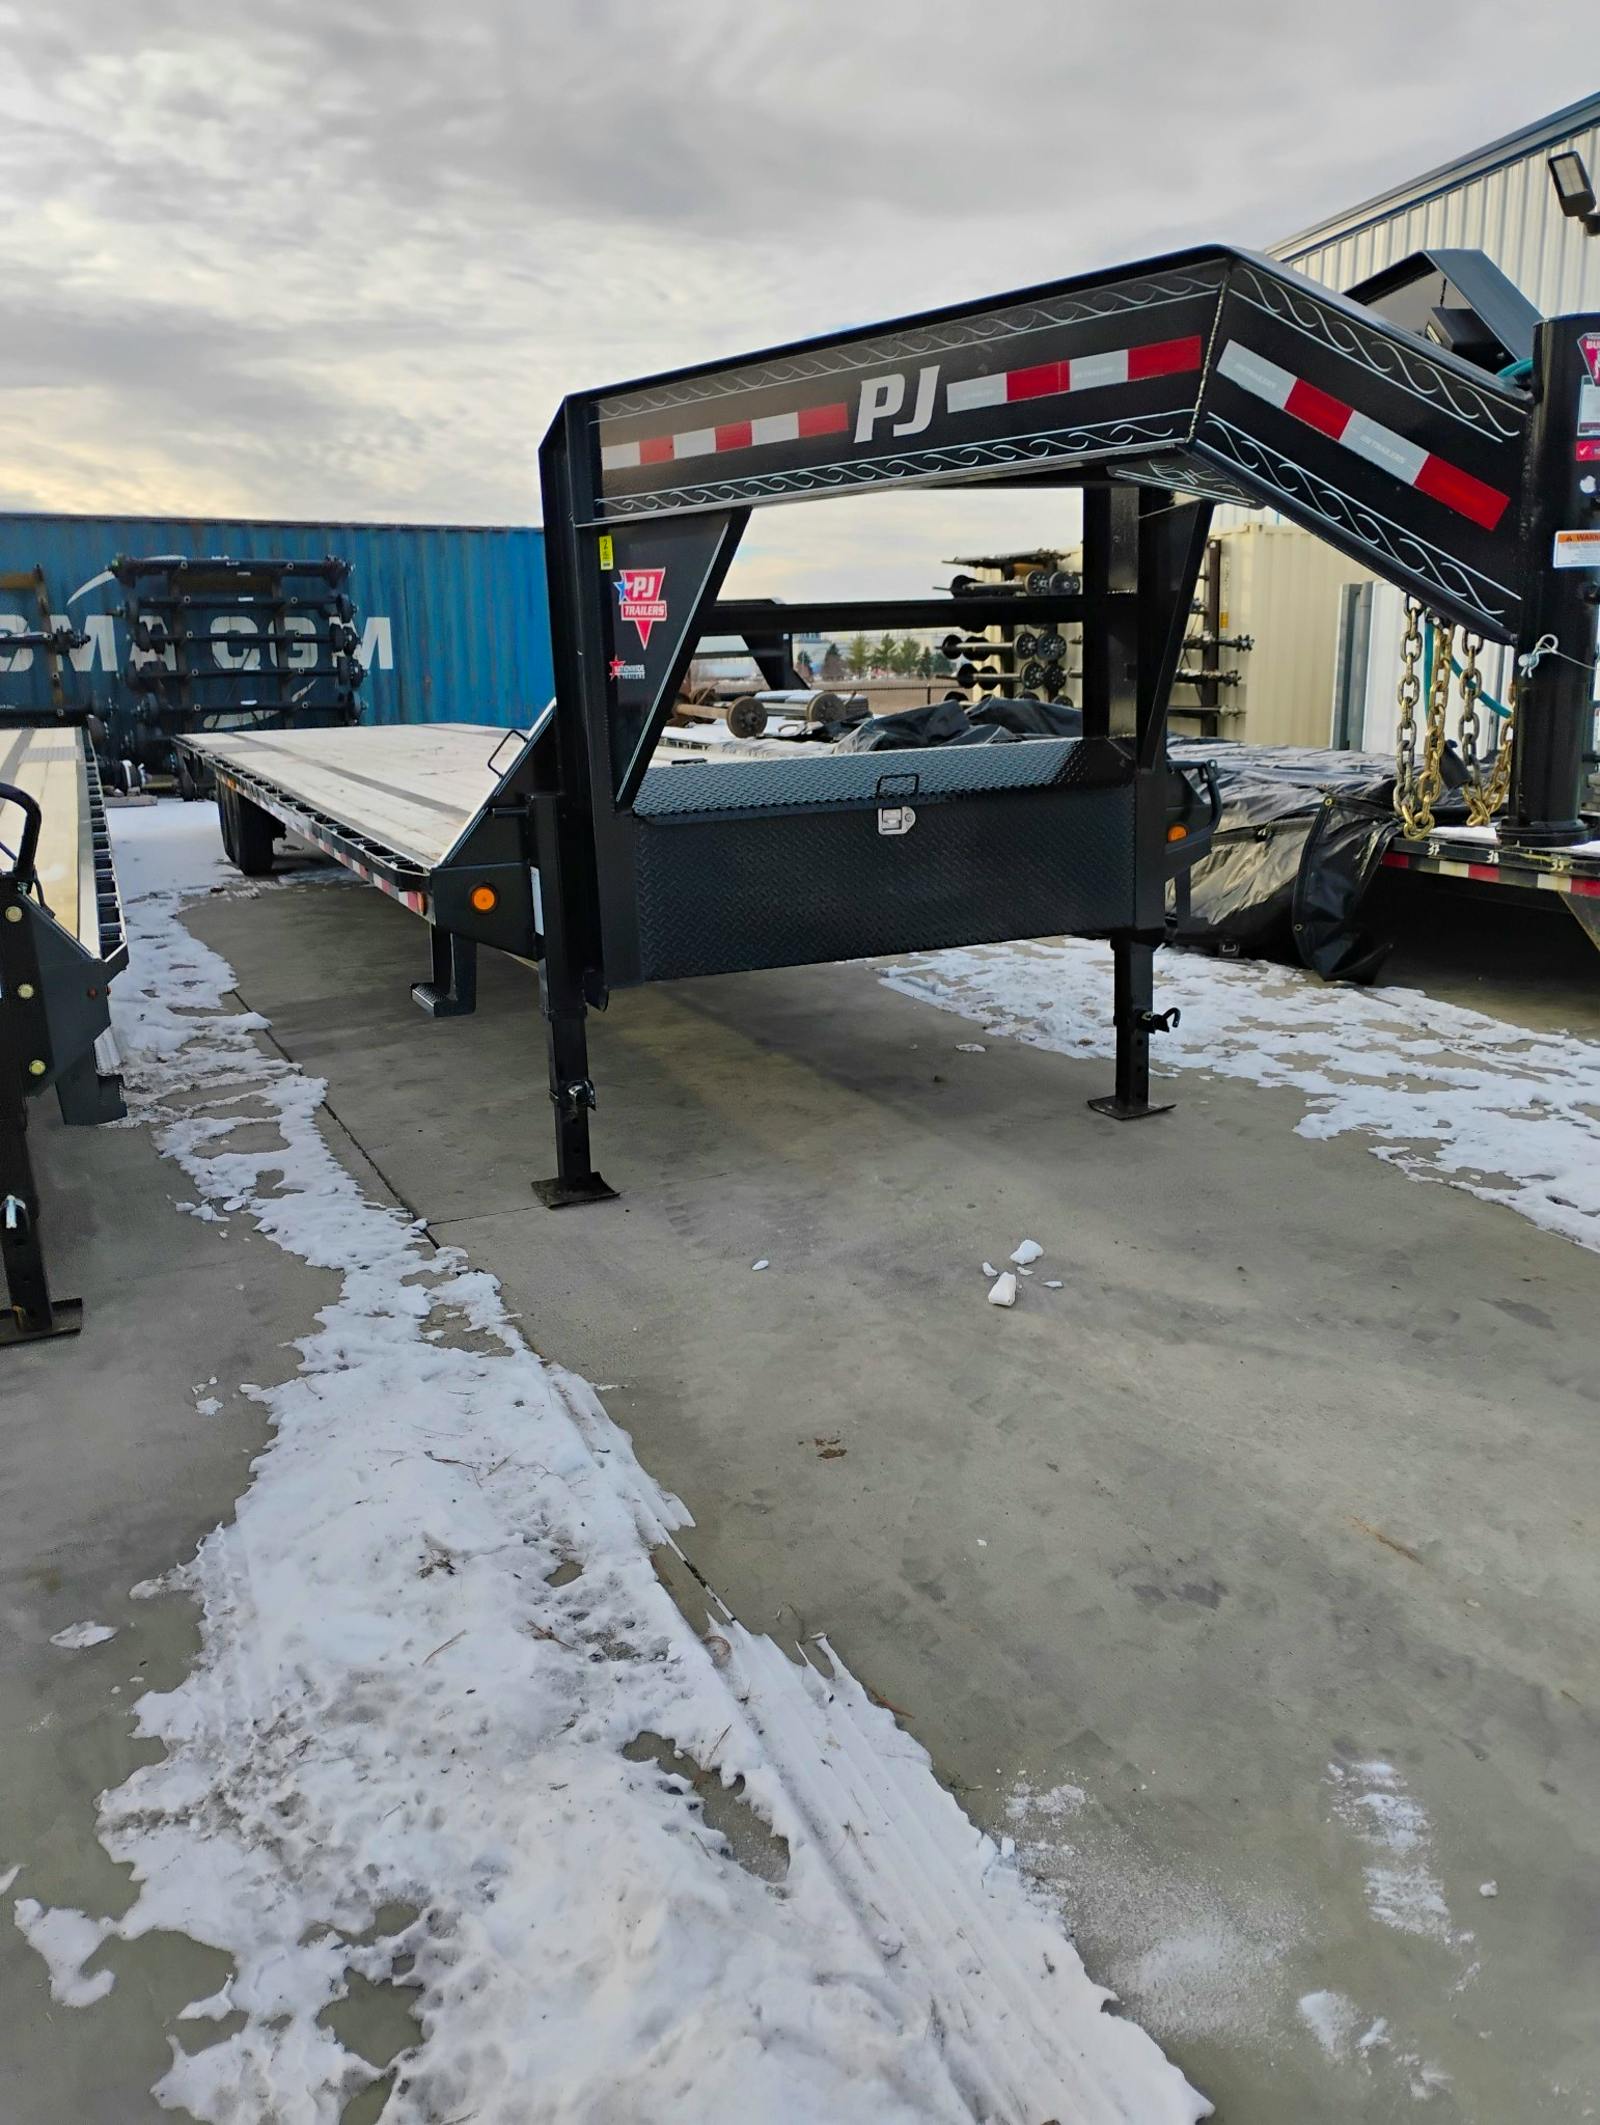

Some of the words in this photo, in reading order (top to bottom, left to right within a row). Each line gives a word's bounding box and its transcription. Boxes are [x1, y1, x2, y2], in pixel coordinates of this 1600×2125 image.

[853, 365, 941, 443] PJ
[633, 576, 655, 598] PJ
[624, 605, 665, 617] TRAILERS
